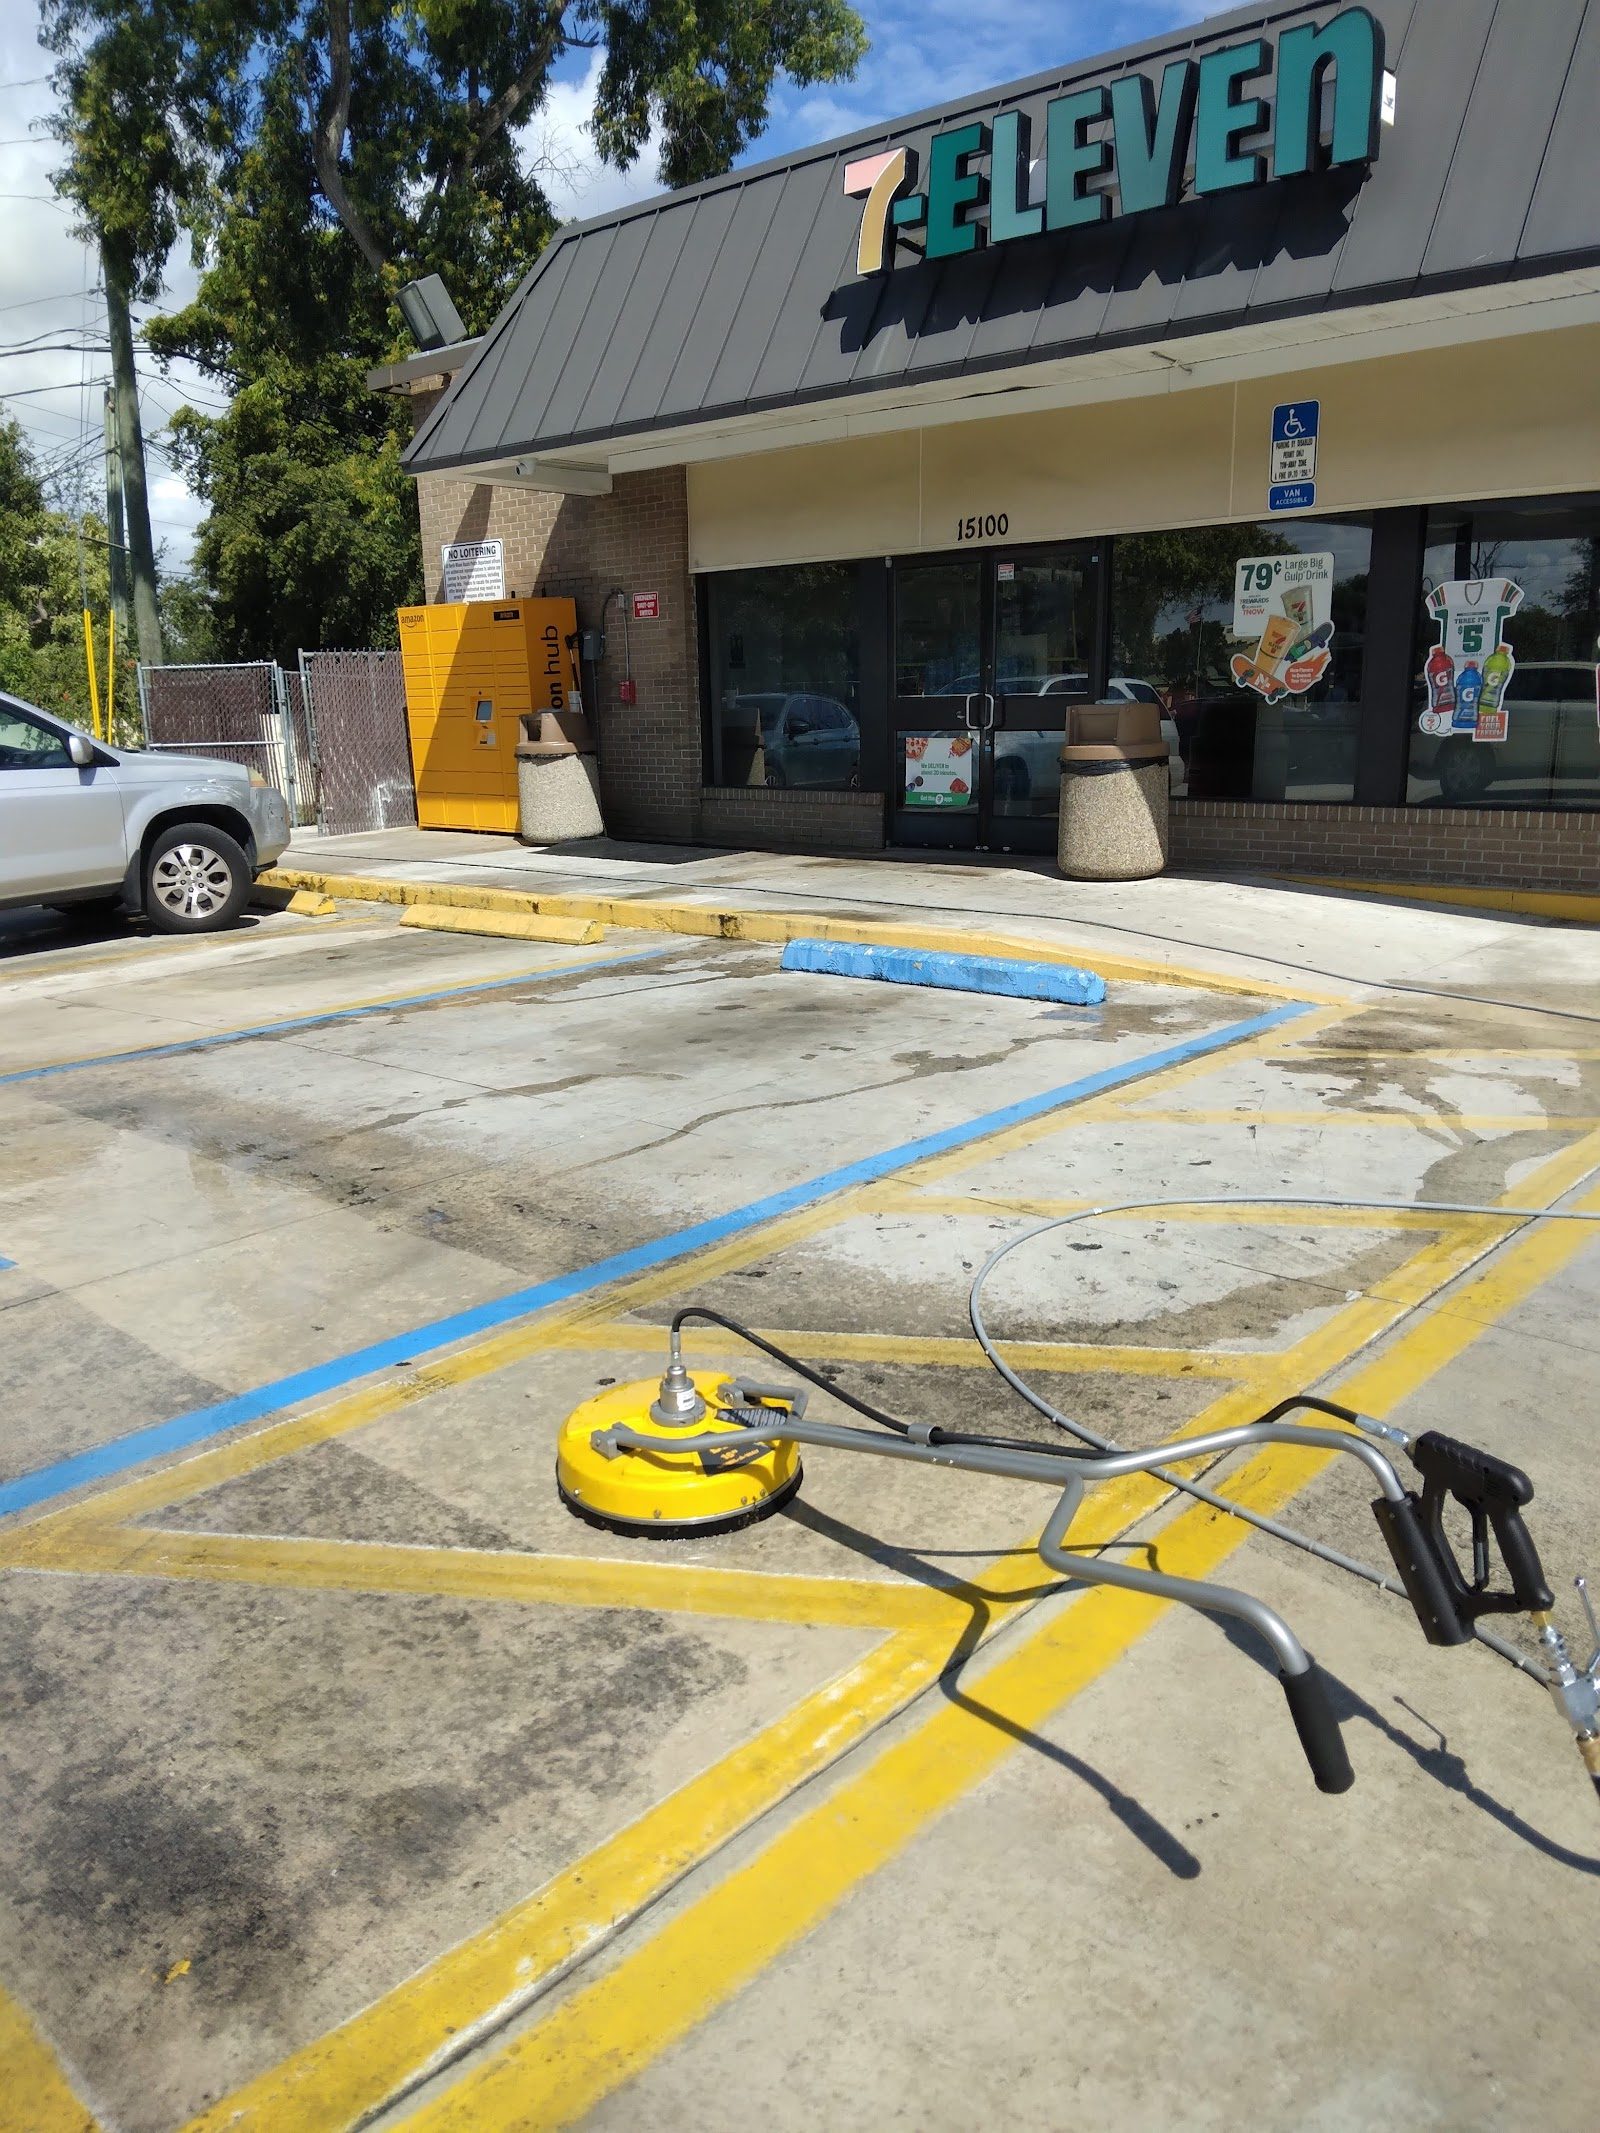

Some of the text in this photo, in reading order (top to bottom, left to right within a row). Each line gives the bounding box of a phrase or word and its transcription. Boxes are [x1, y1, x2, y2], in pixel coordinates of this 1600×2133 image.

[1284, 488, 1301, 498] VAN
[1276, 496, 1308, 506] ACCESSIBLE
[957, 513, 1009, 542] 15100
[448, 545, 496, 560] NO LOITERING
[1285, 558, 1324, 570] Large Big
[1306, 569, 1328, 580] Drink
[401, 614, 424, 624] amazon
[541, 625, 560, 675] hub
[1436, 671, 1448, 687] G
[1462, 687, 1474, 702] G
